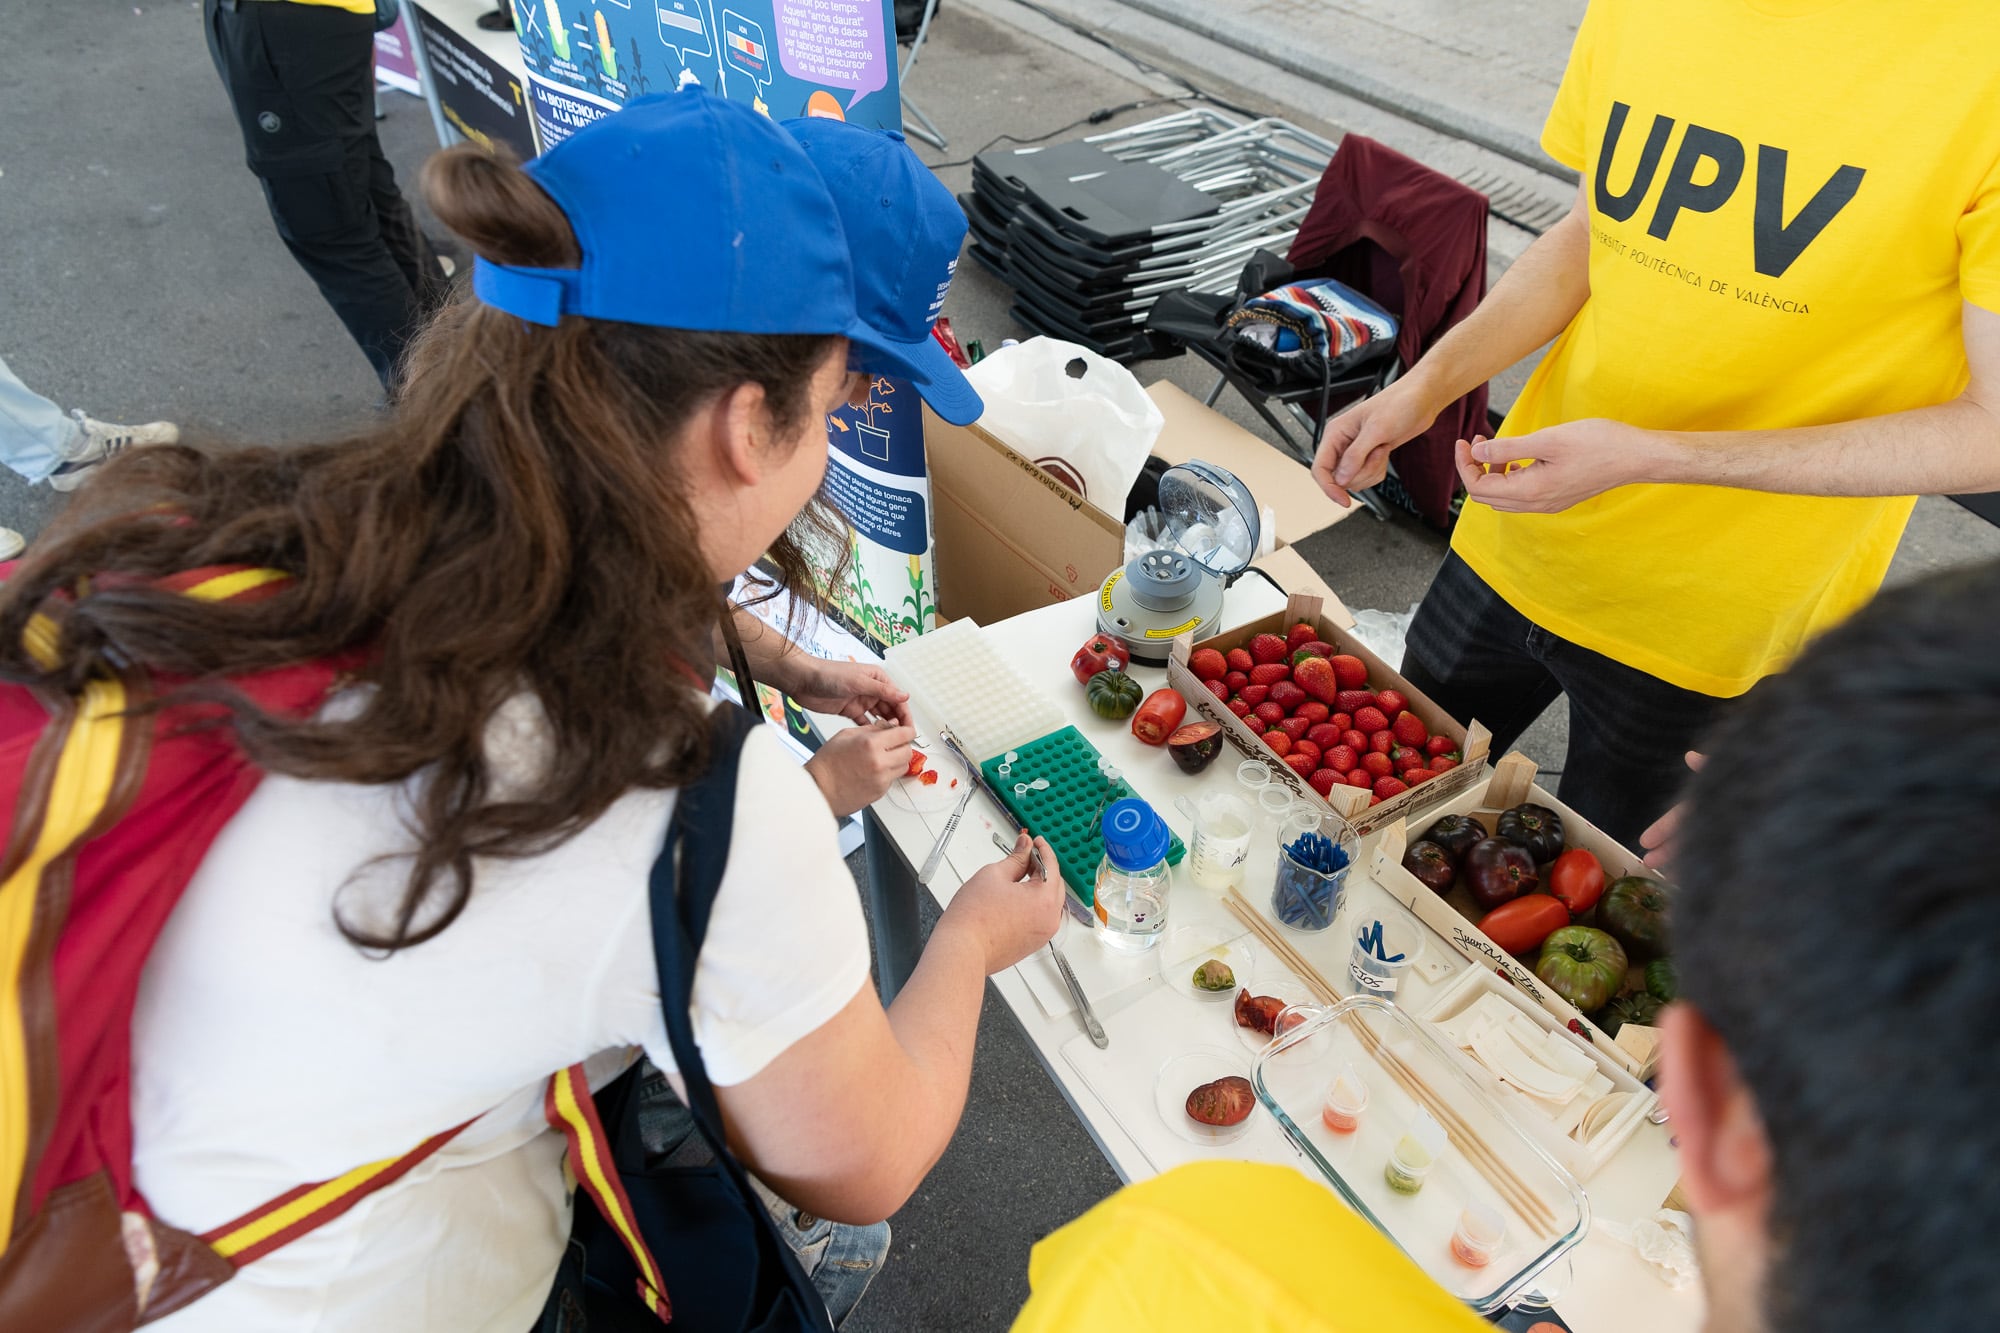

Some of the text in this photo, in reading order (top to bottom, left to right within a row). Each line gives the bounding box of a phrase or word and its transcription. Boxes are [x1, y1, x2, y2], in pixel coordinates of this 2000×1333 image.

[783, 4, 807, 18] Aquest
[830, 1, 861, 15] temps.
[812, 22, 827, 33] gen
[828, 24, 839, 35] de
[841, 26, 868, 38] dacsa
[834, 36, 864, 49] bacteri
[798, 61, 808, 71] de
[817, 65, 850, 79] vitamina
[826, 57, 866, 70] precursor
[536, 87, 548, 104] LA
[552, 107, 560, 120] A
[559, 109, 573, 126] LA
[1594, 100, 1867, 278] UPV
[1629, 248, 1702, 288] POLITÈCNICA
[1708, 278, 1729, 296] DE
[1736, 286, 1810, 315] VALÈNCIA
[851, 476, 873, 493] plantes
[873, 487, 882, 497] de
[883, 491, 913, 504] tomaca
[865, 494, 887, 508] alguns
[888, 502, 908, 512] gens
[865, 502, 889, 517] tomaca
[890, 511, 905, 521] que
[876, 523, 902, 538] d'altres
[883, 518, 896, 528] per
[1103, 576, 1118, 611] WARNING
